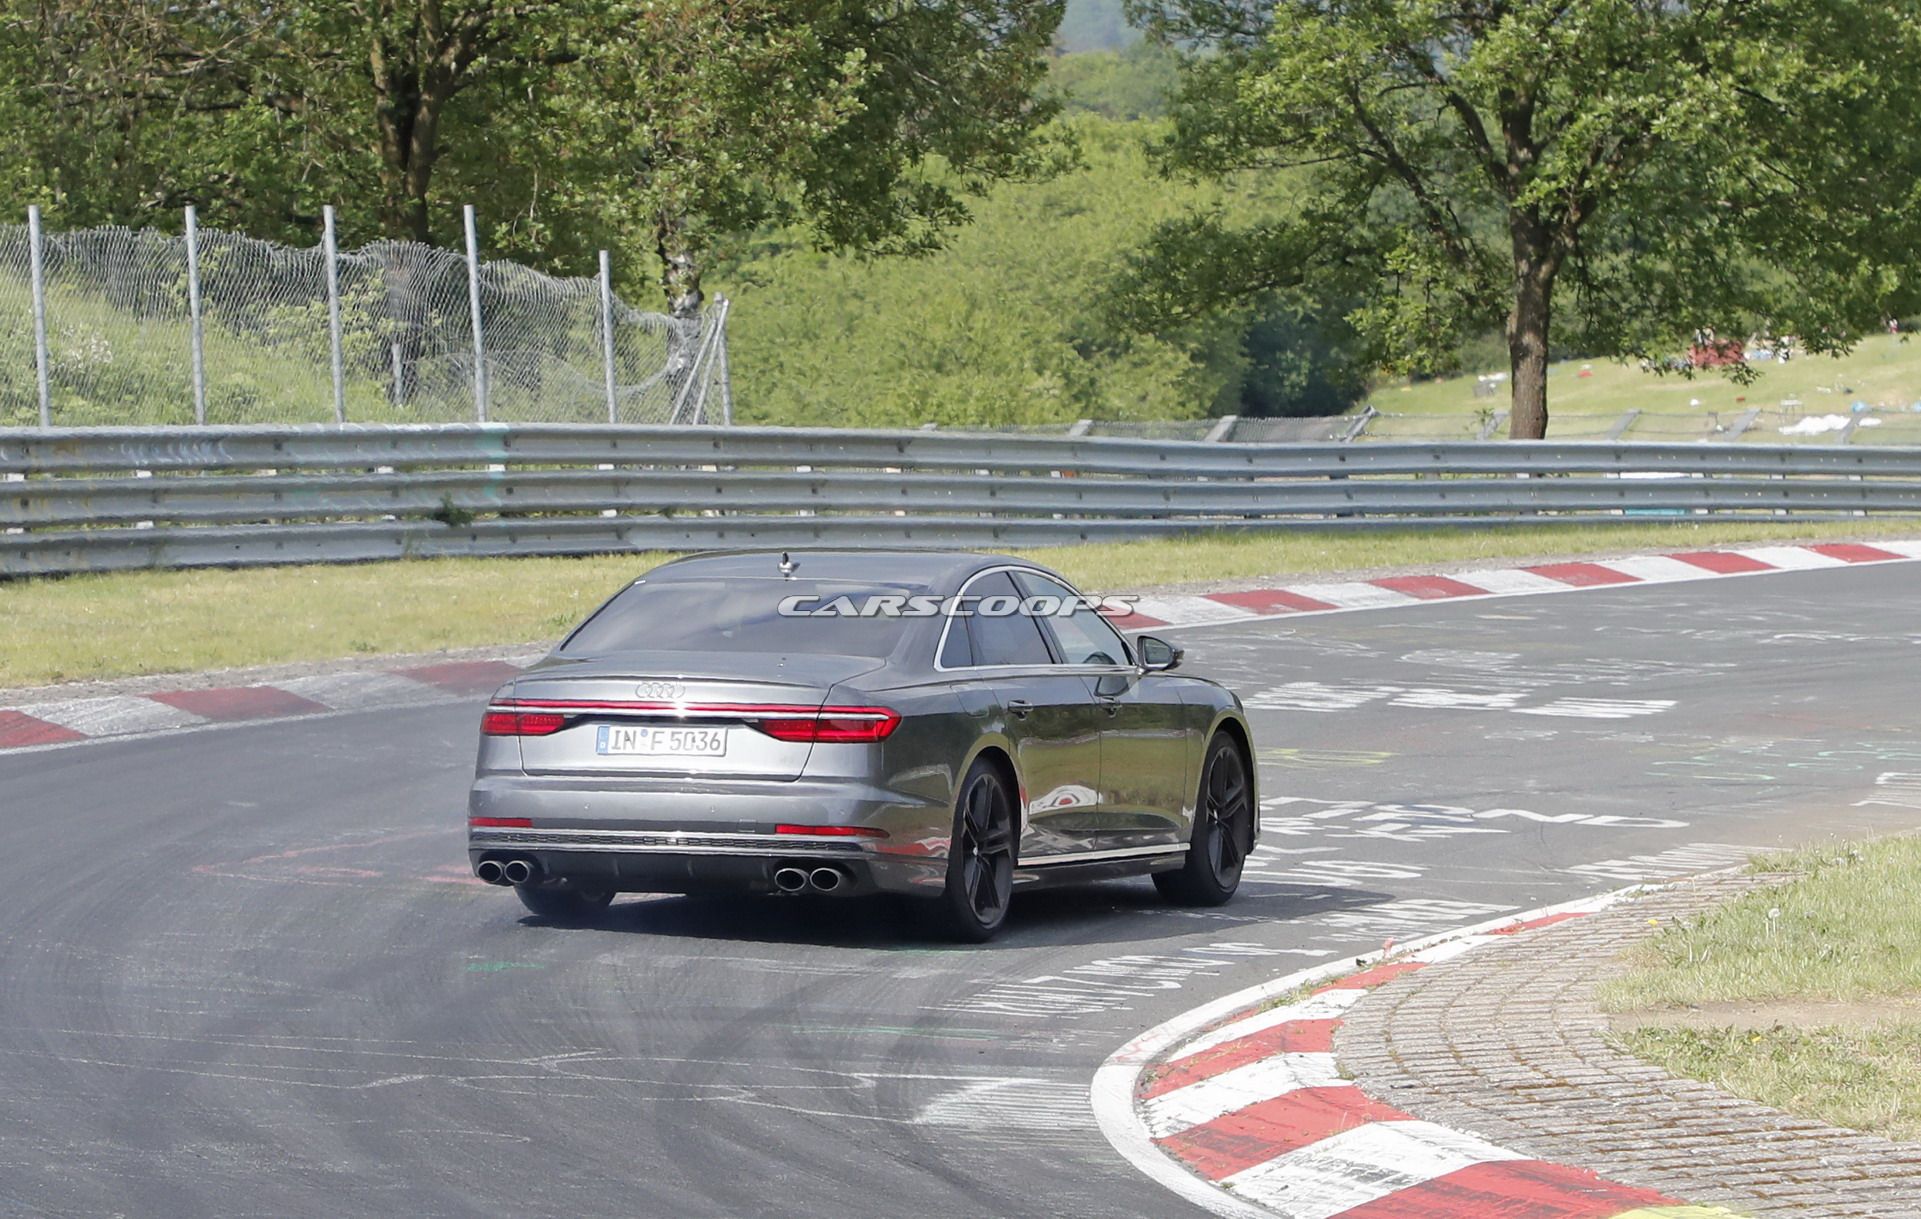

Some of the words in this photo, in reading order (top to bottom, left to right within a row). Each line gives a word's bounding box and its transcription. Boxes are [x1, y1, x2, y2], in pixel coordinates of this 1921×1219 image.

[611, 730, 637, 750] IN
[651, 731, 665, 750] F
[670, 731, 721, 751] 5036
